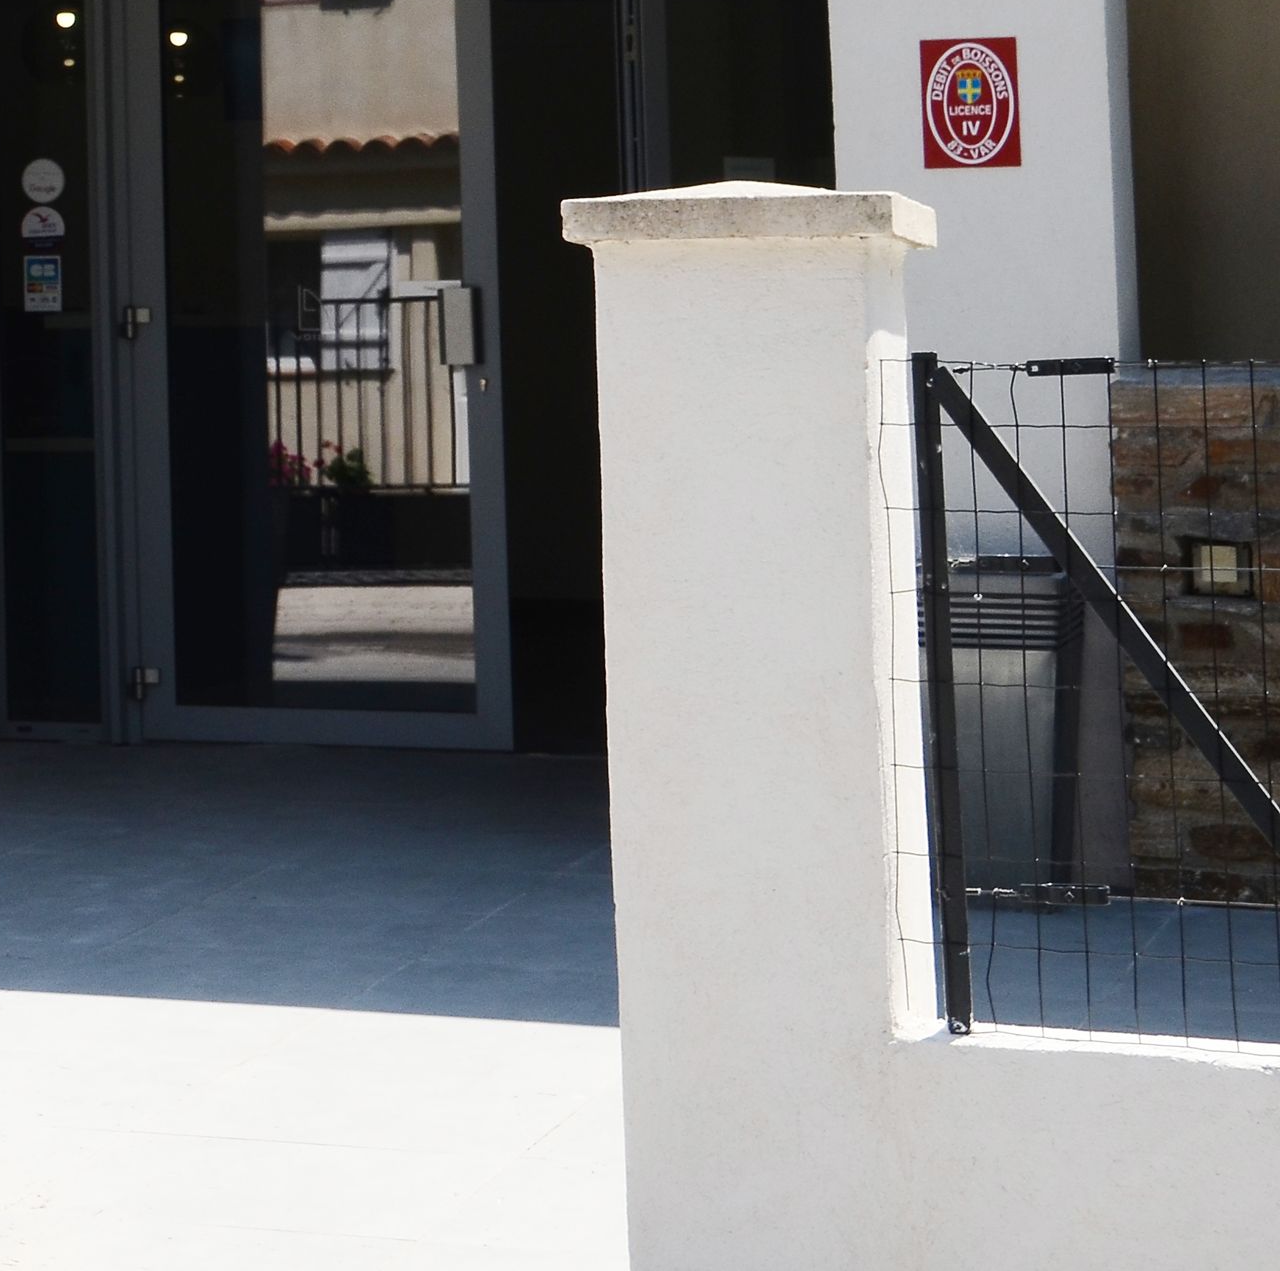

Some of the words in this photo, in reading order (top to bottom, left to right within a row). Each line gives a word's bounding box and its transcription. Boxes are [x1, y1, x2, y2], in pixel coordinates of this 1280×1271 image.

[932, 61, 951, 101] DEBIT
[962, 48, 1008, 99] BOISSONS
[949, 104, 992, 116] LICENCE
[961, 120, 980, 136] IV
[970, 139, 996, 158] VAR
